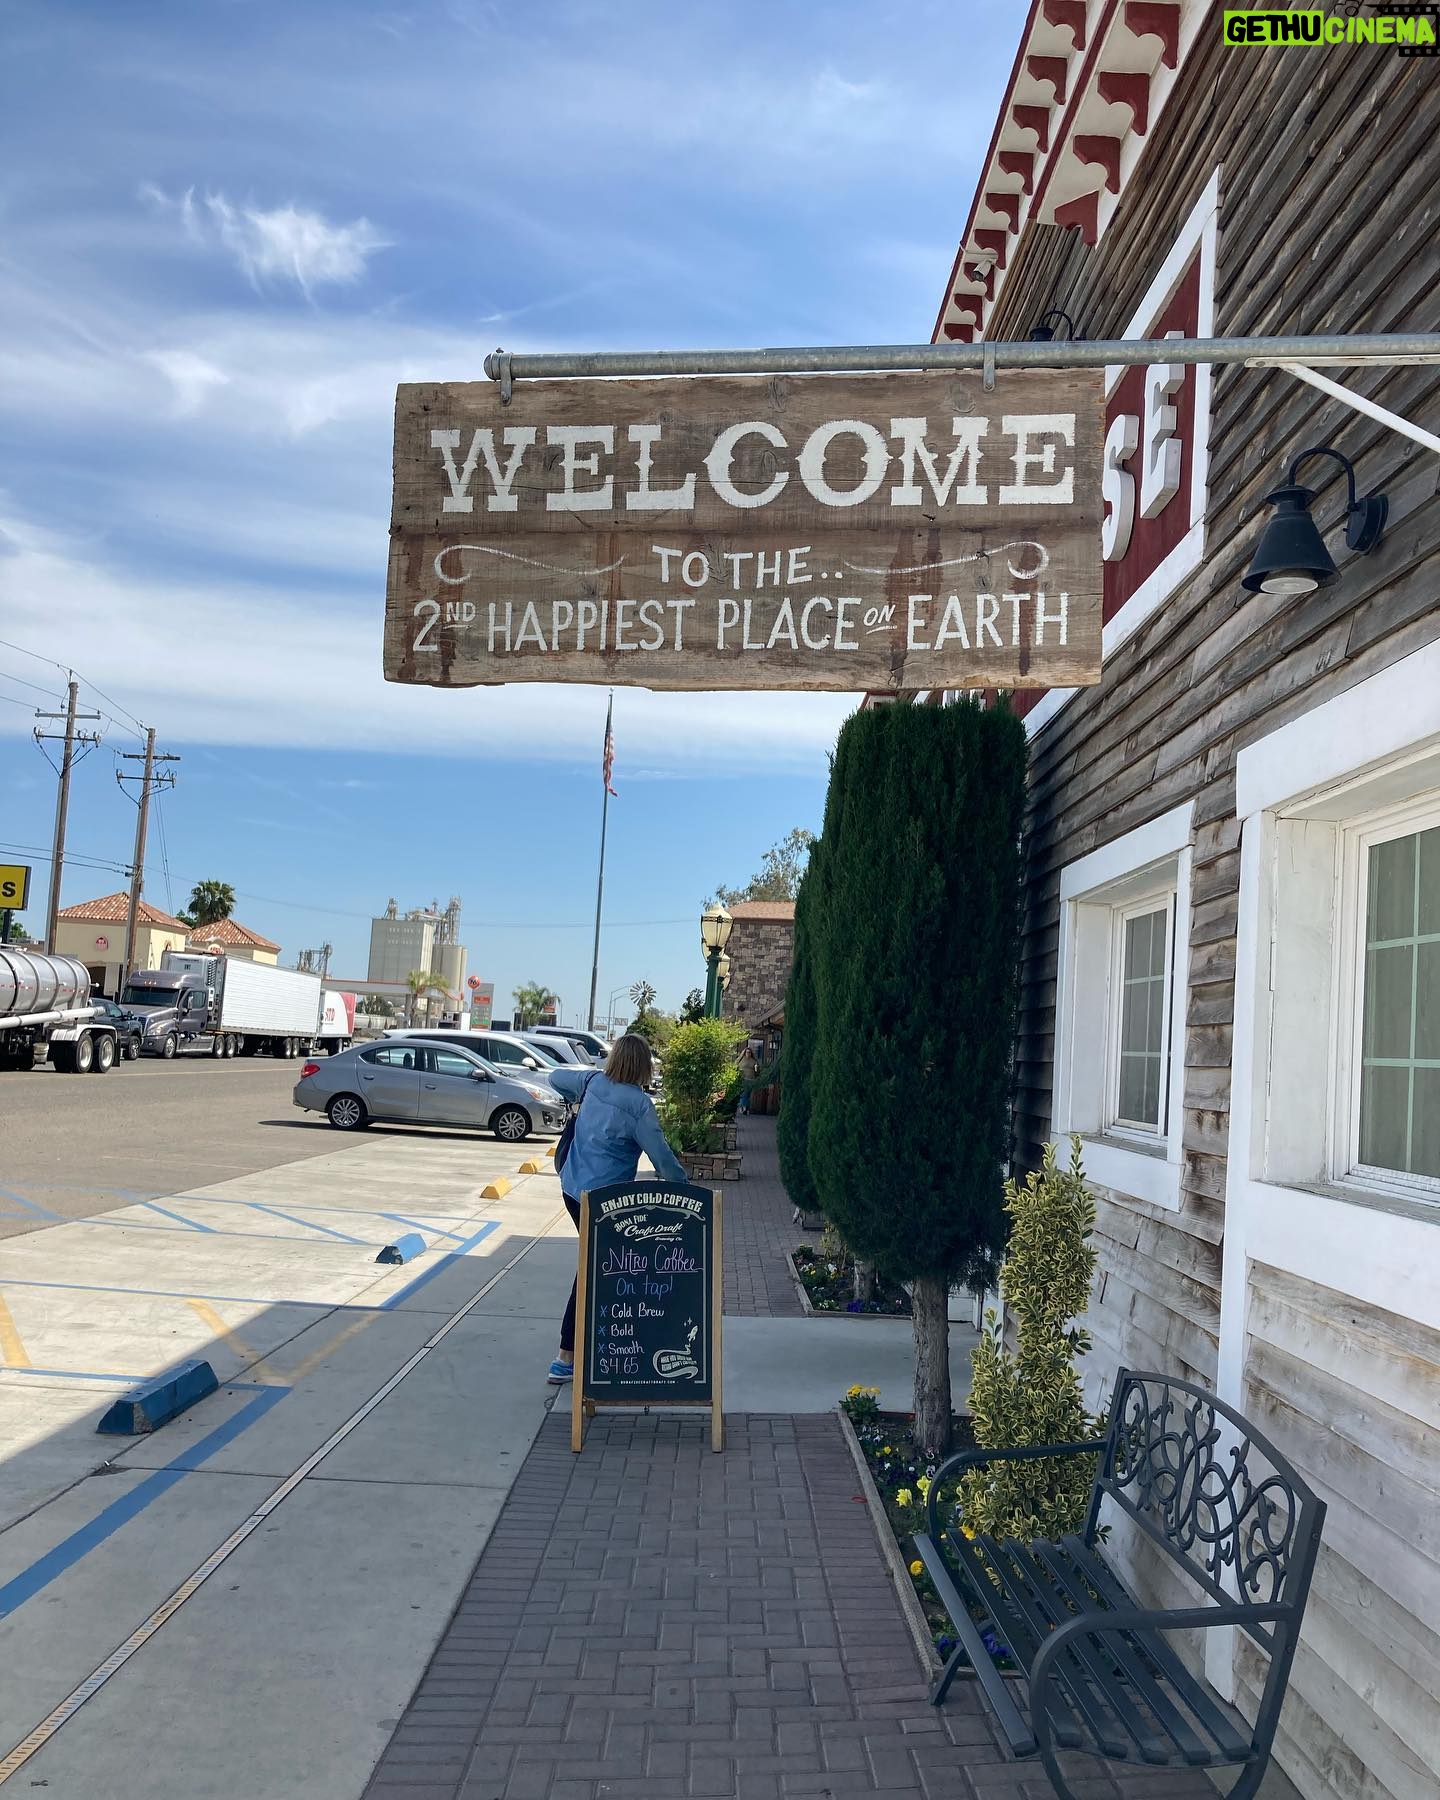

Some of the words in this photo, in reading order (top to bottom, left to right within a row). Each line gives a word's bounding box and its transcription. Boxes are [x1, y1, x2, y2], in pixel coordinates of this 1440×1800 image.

[429, 413, 1076, 513] WELCOME
[651, 545, 710, 587] TO
[487, 599, 696, 652] HAPPIEST
[716, 597, 863, 651] PLACE
[905, 592, 1069, 651] EARTH
[600, 1194, 635, 1213] ENJOY
[637, 1192, 662, 1204] COLD
[664, 1193, 704, 1213] COFFEE
[624, 1225, 655, 1237] Craft
[655, 1222, 683, 1233] Draft
[655, 1244, 703, 1273] Coffee
[616, 1277, 635, 1296] On
[642, 1274, 673, 1301] tap!
[611, 1302, 633, 1318] Cold
[638, 1302, 665, 1318] Brew
[610, 1323, 634, 1337] Bold
[608, 1340, 645, 1355] Smooth
